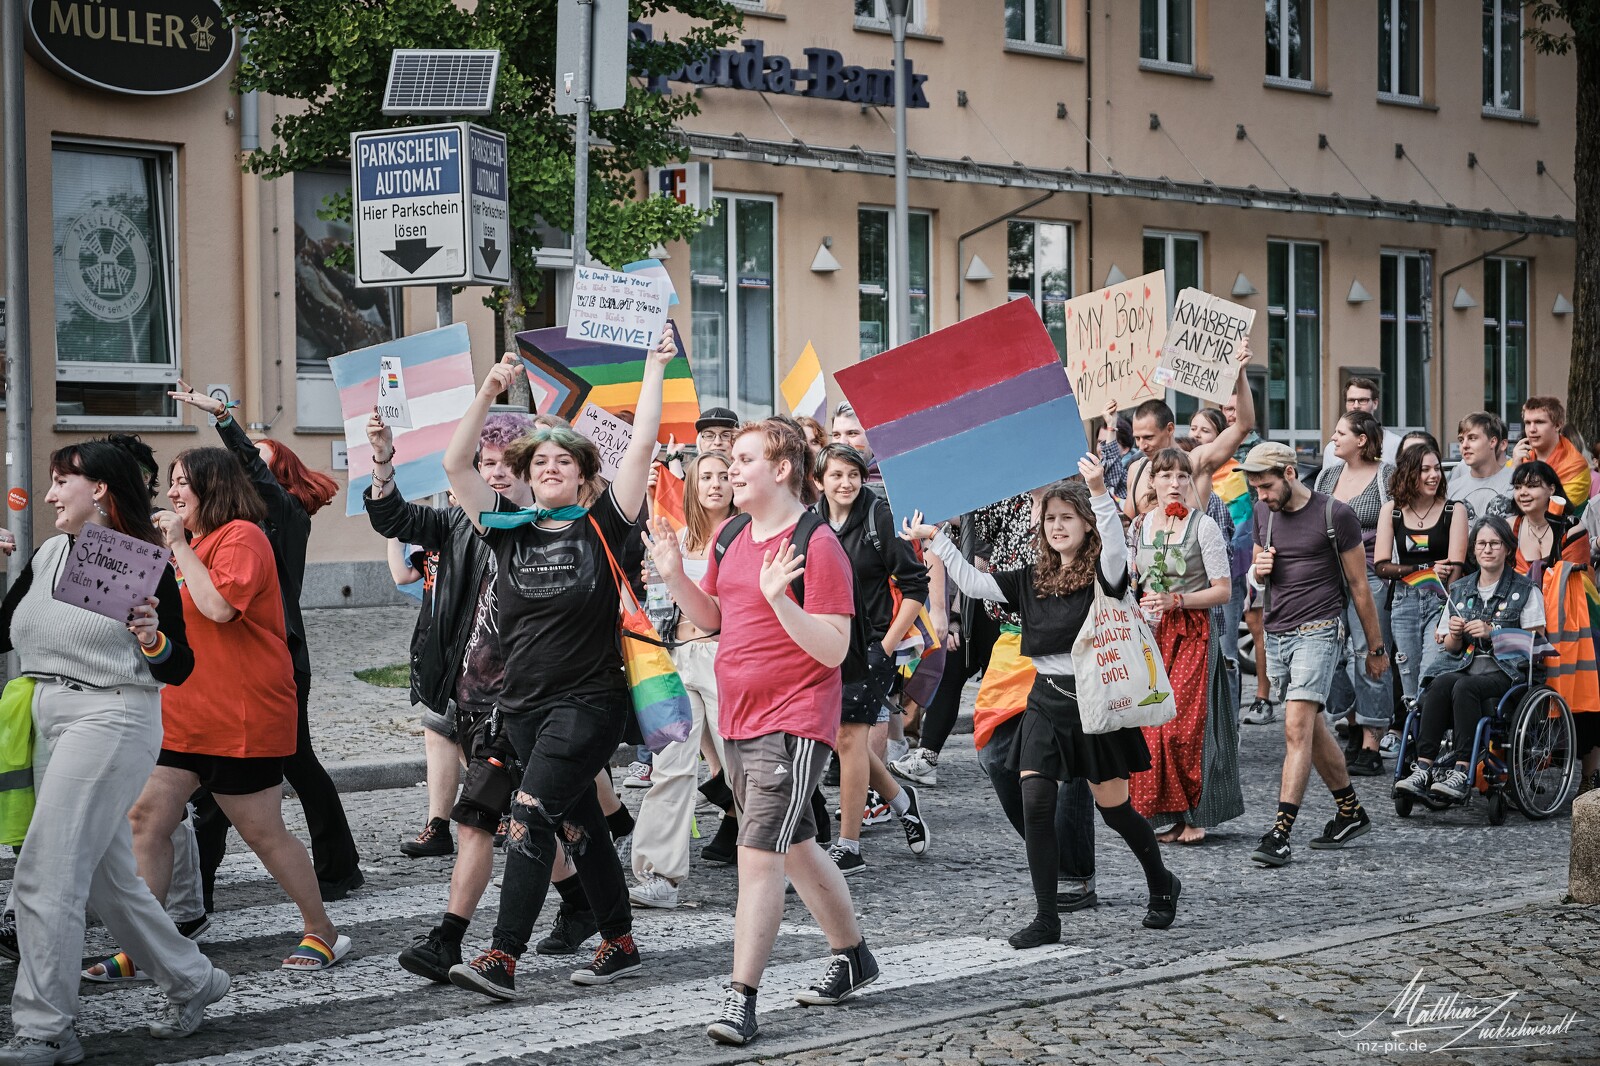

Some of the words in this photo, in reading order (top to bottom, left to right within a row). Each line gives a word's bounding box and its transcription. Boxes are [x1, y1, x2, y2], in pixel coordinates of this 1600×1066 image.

[49, 0, 187, 49] MÜLLER
[361, 137, 457, 168] PARKSCHEIN-
[471, 136, 504, 168] PARKSCHEIN-
[376, 167, 442, 196] AUTOMAT
[476, 168, 500, 195] AUTOMAT
[363, 206, 387, 220] Hier
[392, 199, 458, 218] Parkschein
[472, 201, 481, 213] Hier
[482, 202, 505, 220] Parkschein
[394, 223, 427, 238] lösen
[483, 222, 496, 238] lösen
[579, 269, 589, 280] We
[592, 272, 609, 281] Don't
[631, 278, 652, 288] Your
[1175, 299, 1247, 341] KNABBER
[579, 320, 653, 347] SURVIVE!
[1174, 330, 1203, 354] AN
[1202, 336, 1234, 365] MIR
[1201, 367, 1220, 382] AN
[585, 406, 598, 421] We
[601, 419, 617, 431] are
[86, 529, 116, 545] einfach
[120, 538, 134, 552] mal
[136, 545, 149, 556] die
[76, 542, 129, 575] Schnauze
[67, 565, 92, 588] halten
[1112, 608, 1129, 624] DIE
[1092, 627, 1131, 649] QUALITÄT
[1096, 648, 1121, 667] OHNE
[1101, 664, 1129, 685] ENDE!
[1108, 696, 1132, 710] Netto
